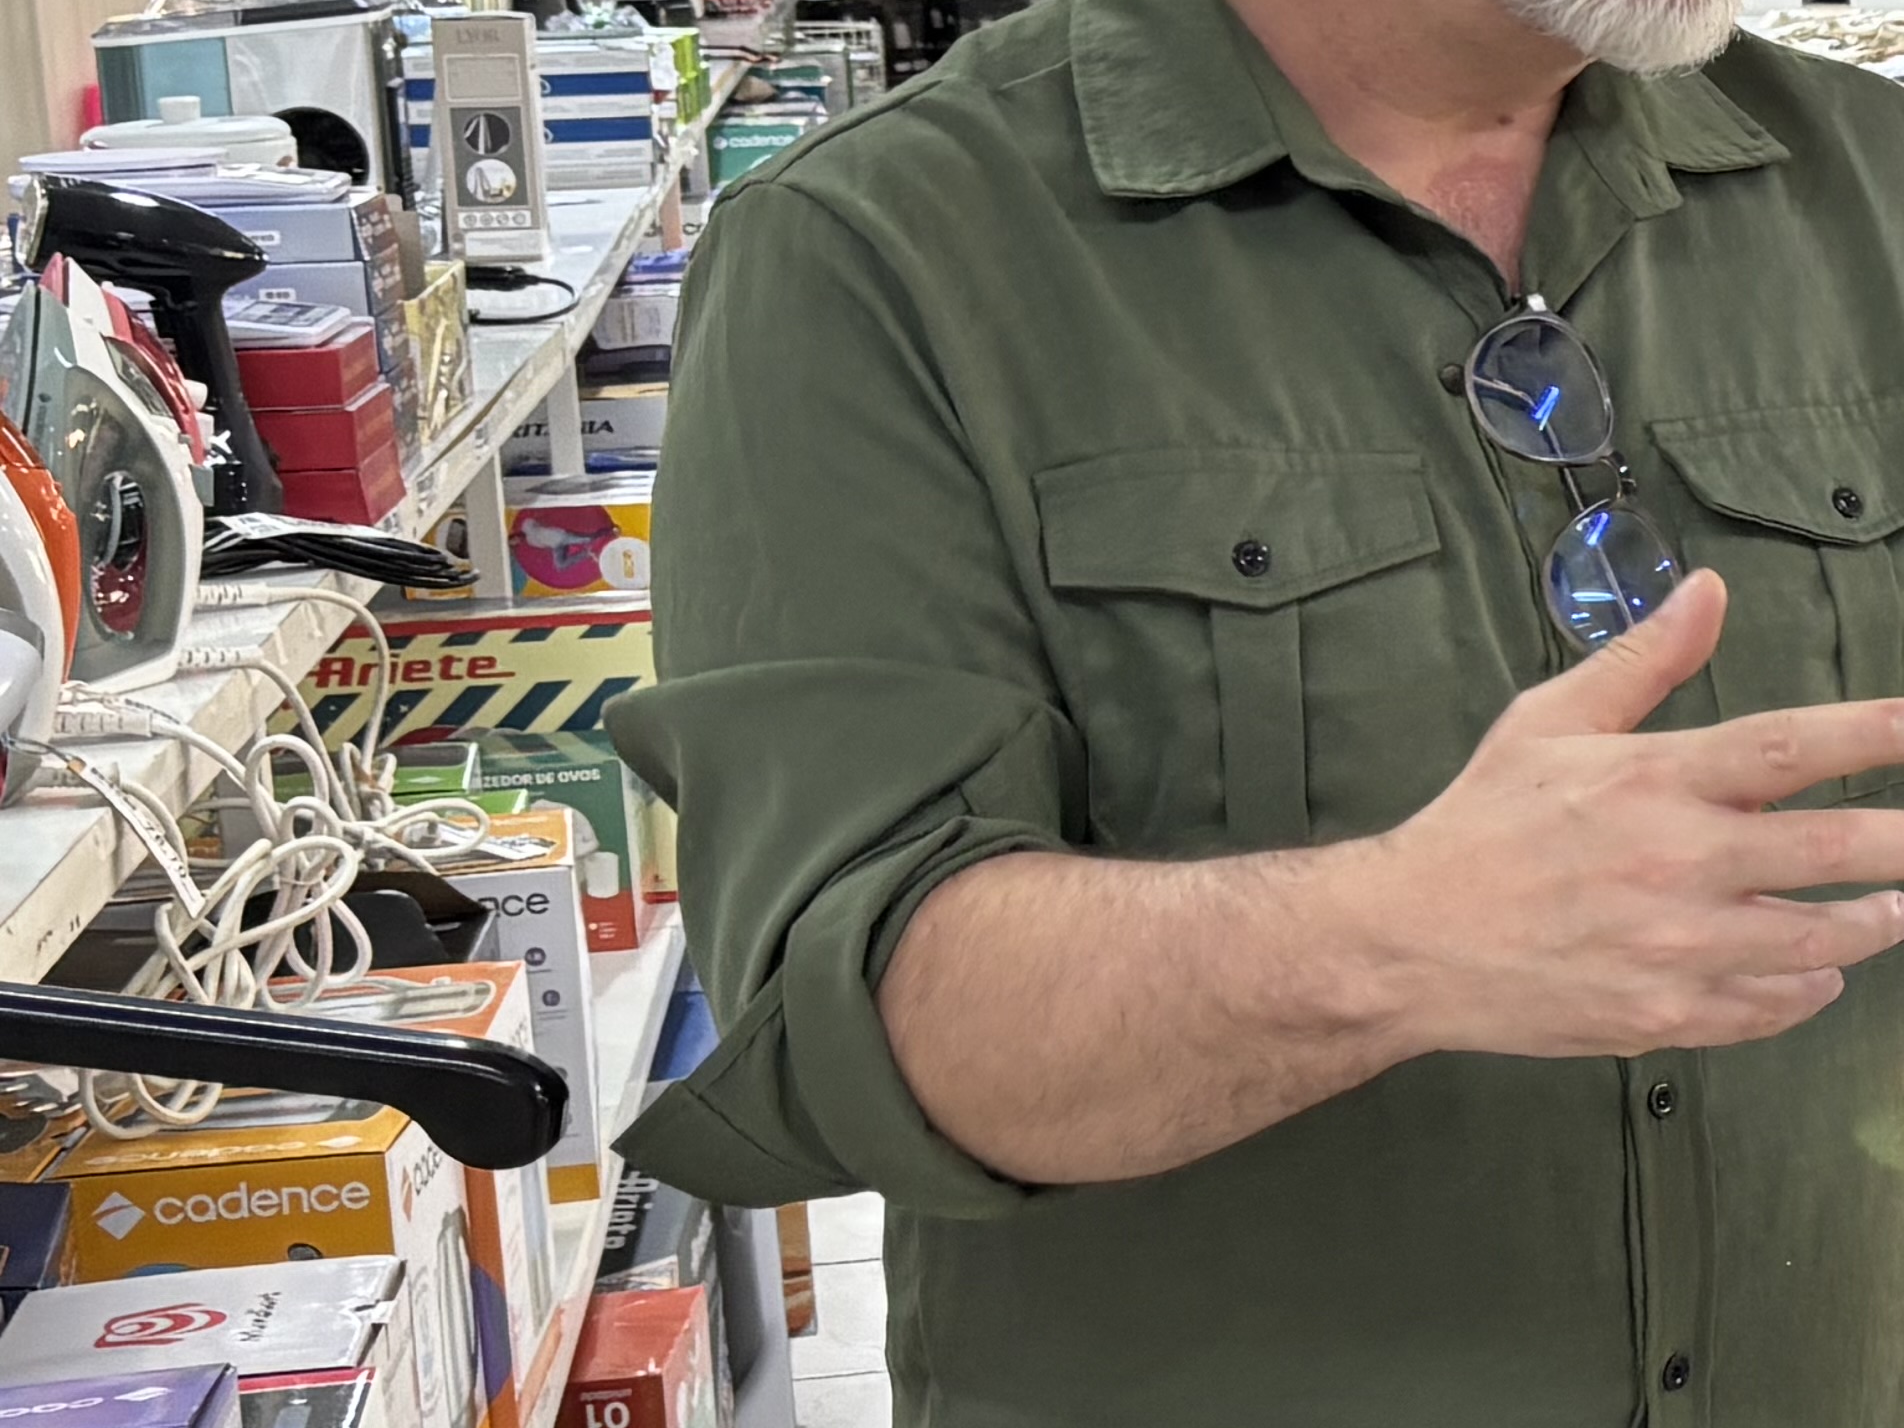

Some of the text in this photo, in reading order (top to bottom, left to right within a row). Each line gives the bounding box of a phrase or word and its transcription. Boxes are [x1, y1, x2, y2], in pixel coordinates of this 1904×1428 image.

[307, 653, 516, 689] Ariete
[474, 772, 534, 790] ZEDOR
[557, 768, 602, 783] OVOS
[153, 1180, 371, 1226] cadence
